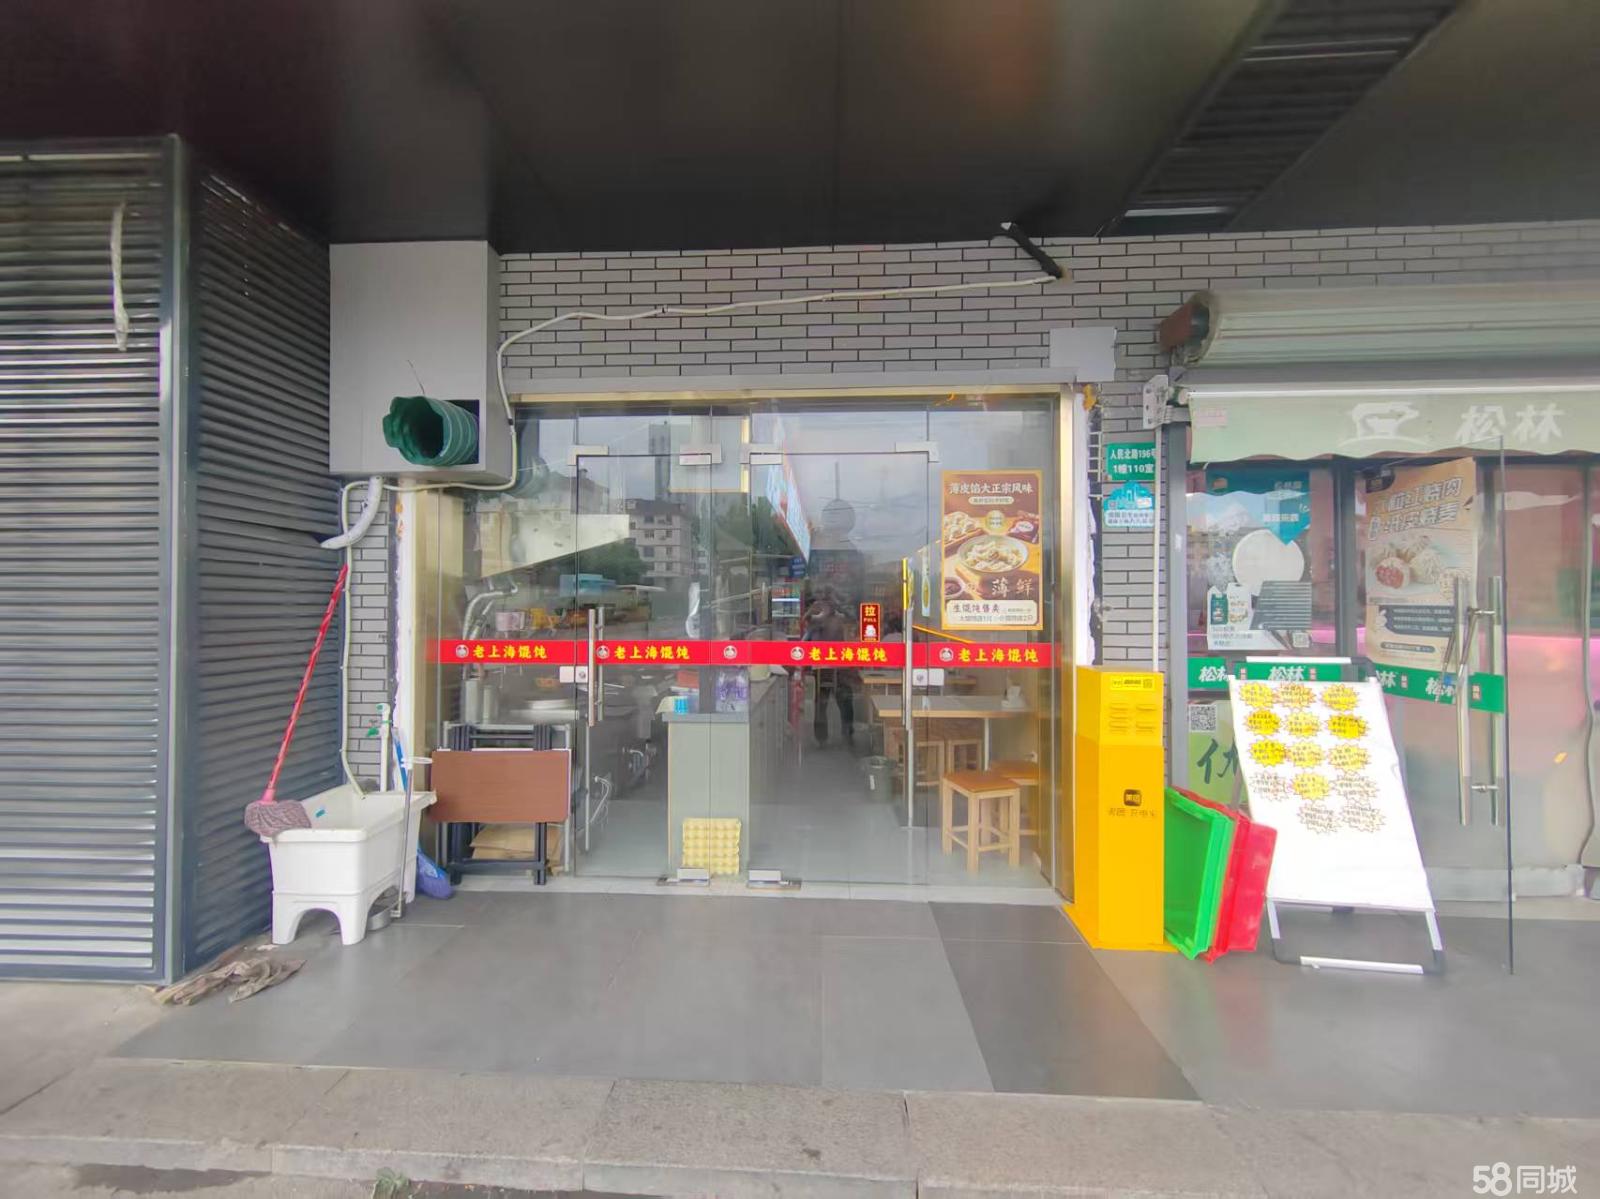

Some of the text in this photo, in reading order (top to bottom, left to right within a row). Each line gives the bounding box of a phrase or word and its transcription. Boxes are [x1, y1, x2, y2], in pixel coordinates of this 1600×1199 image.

[1457, 404, 1563, 444] 松林
[950, 482, 1033, 495] 薄皮馅大正宗风味
[864, 606, 877, 617] 拉
[473, 645, 548, 660] 老上海馄饨
[614, 645, 690, 661] 老上海馄饨
[808, 646, 888, 662] 老上海馄饨
[958, 648, 1039, 664] 老上海馄饨
[1269, 665, 1305, 682] 松林
